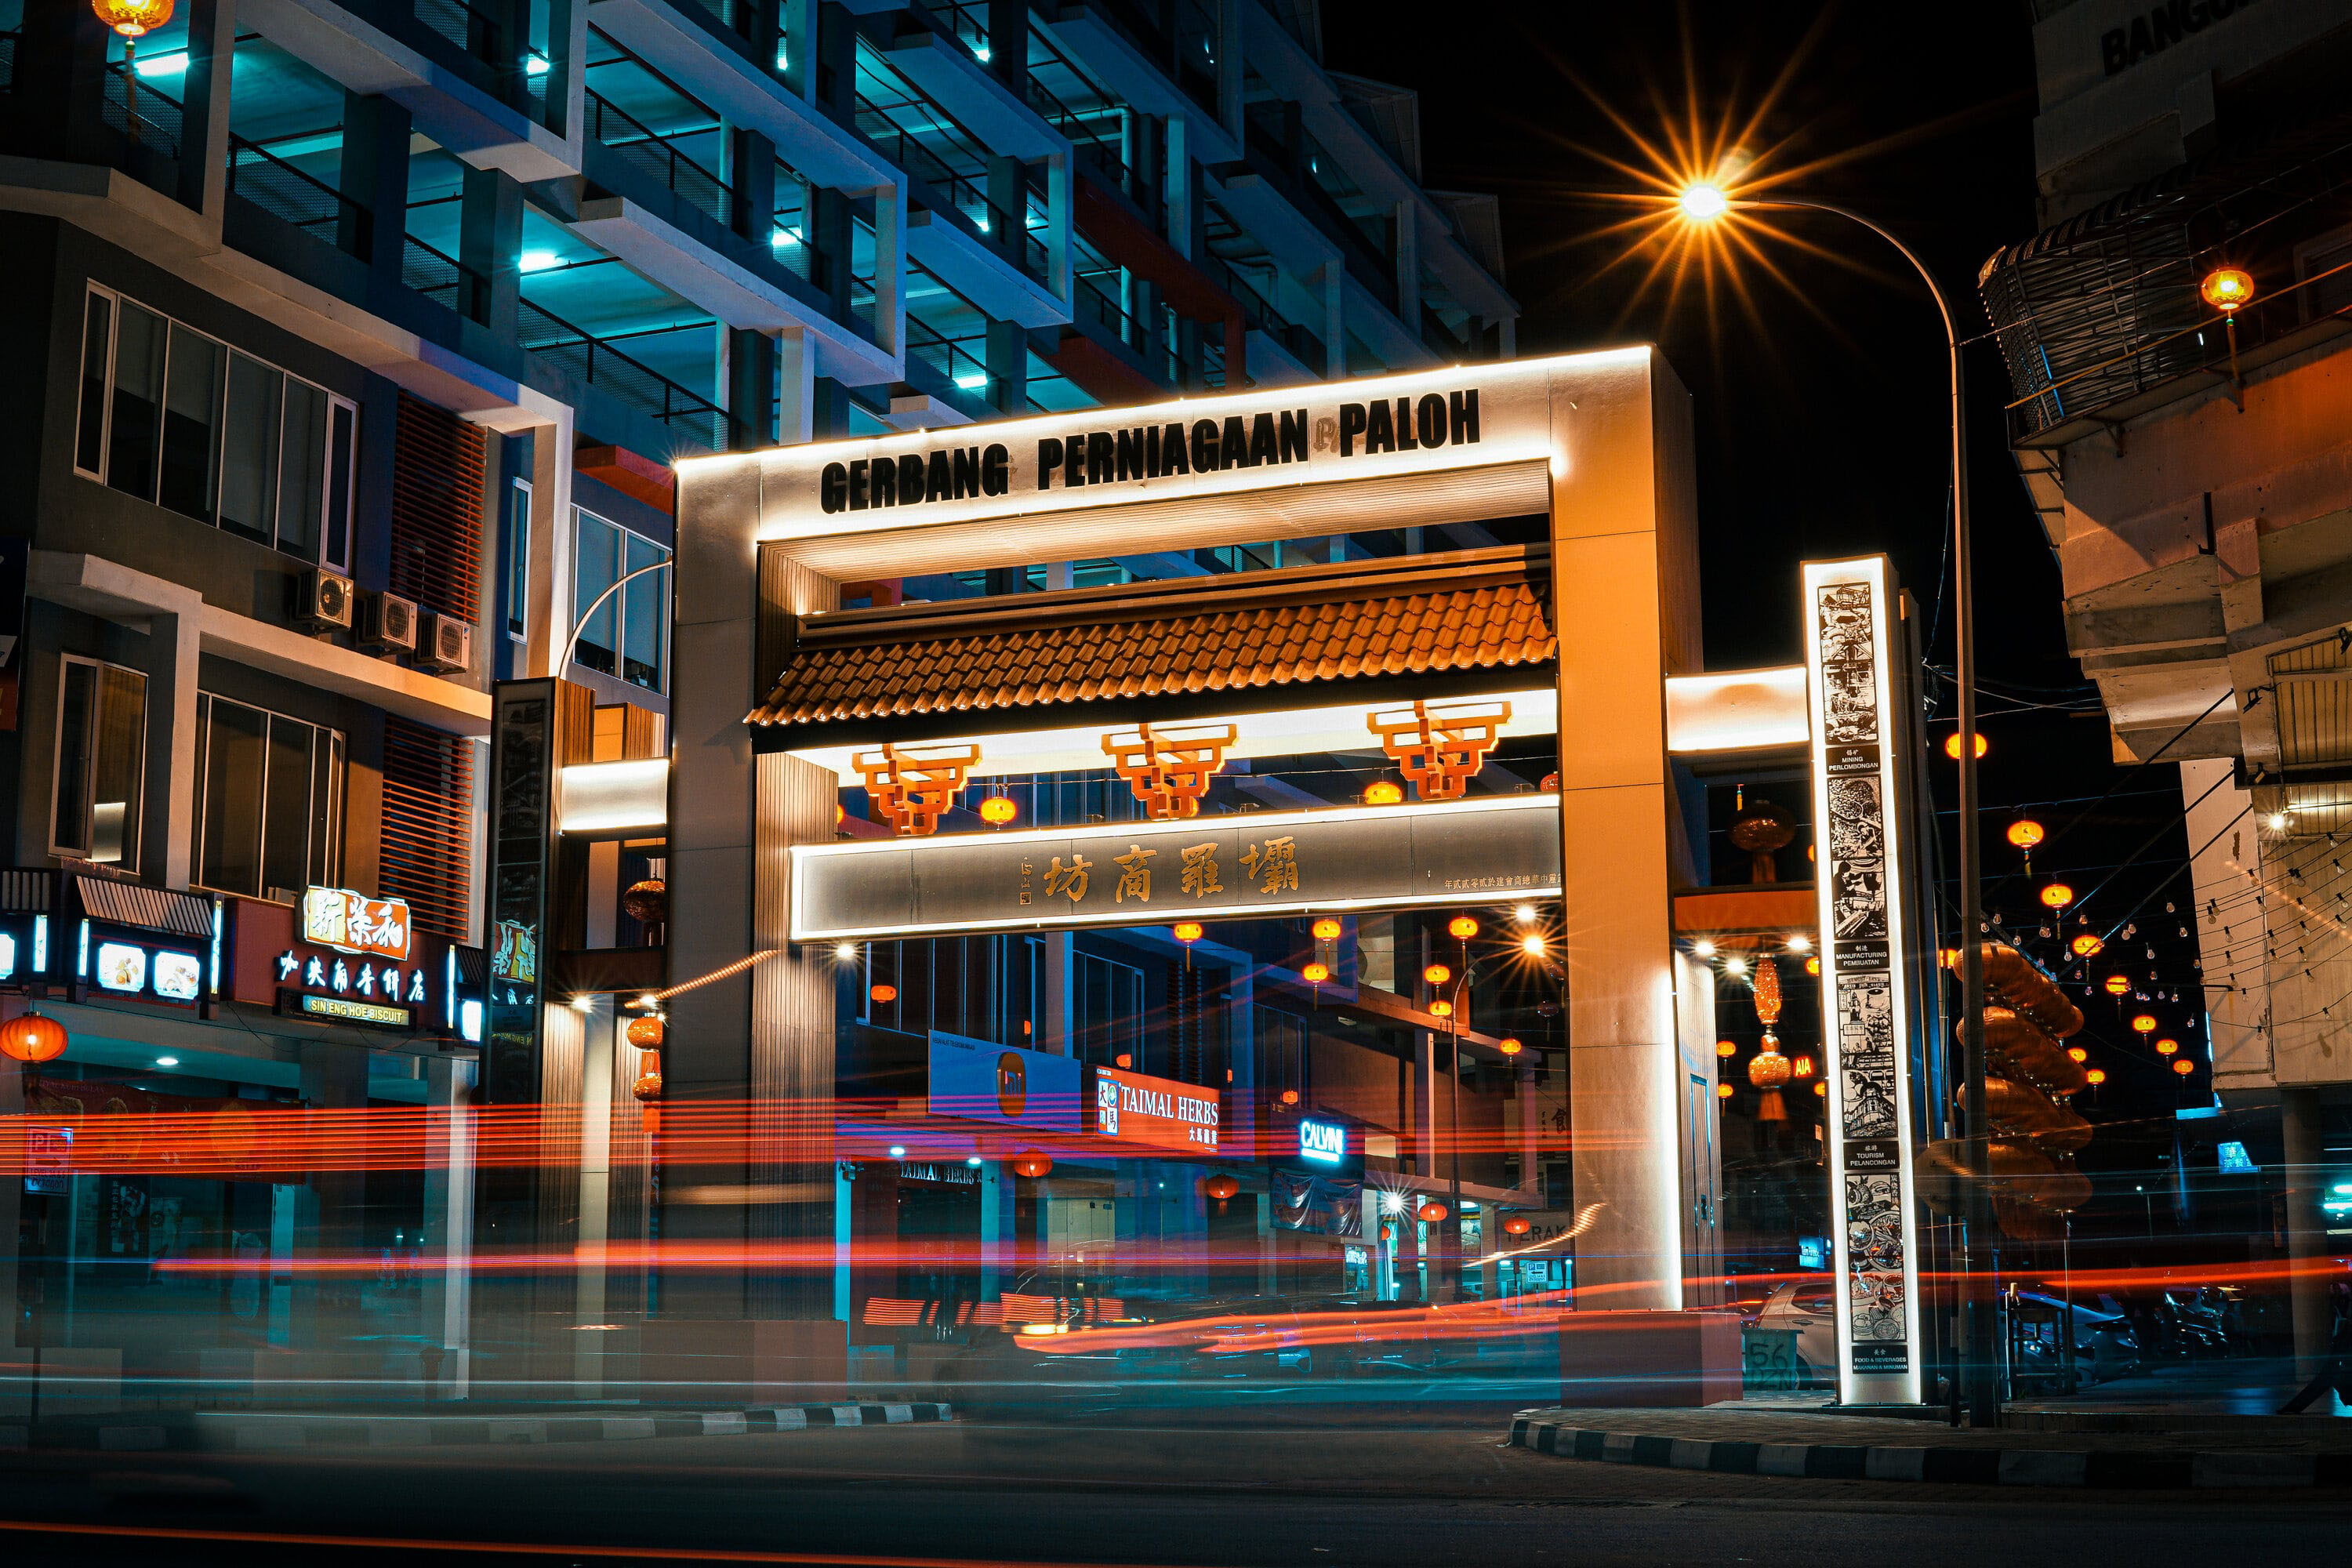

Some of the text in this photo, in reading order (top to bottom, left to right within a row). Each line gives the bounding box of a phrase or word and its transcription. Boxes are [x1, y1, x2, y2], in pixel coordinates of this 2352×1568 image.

[821, 389, 1480, 514] GERBANG PERNIAGAAN PALOH
[1828, 762, 1878, 771] PERLOMBONGAN
[310, 1000, 402, 1023] SIN ENG HOE BISCUIT
[1795, 1058, 1811, 1076] AIA
[1120, 1085, 1219, 1127] TAIMAL HERBS
